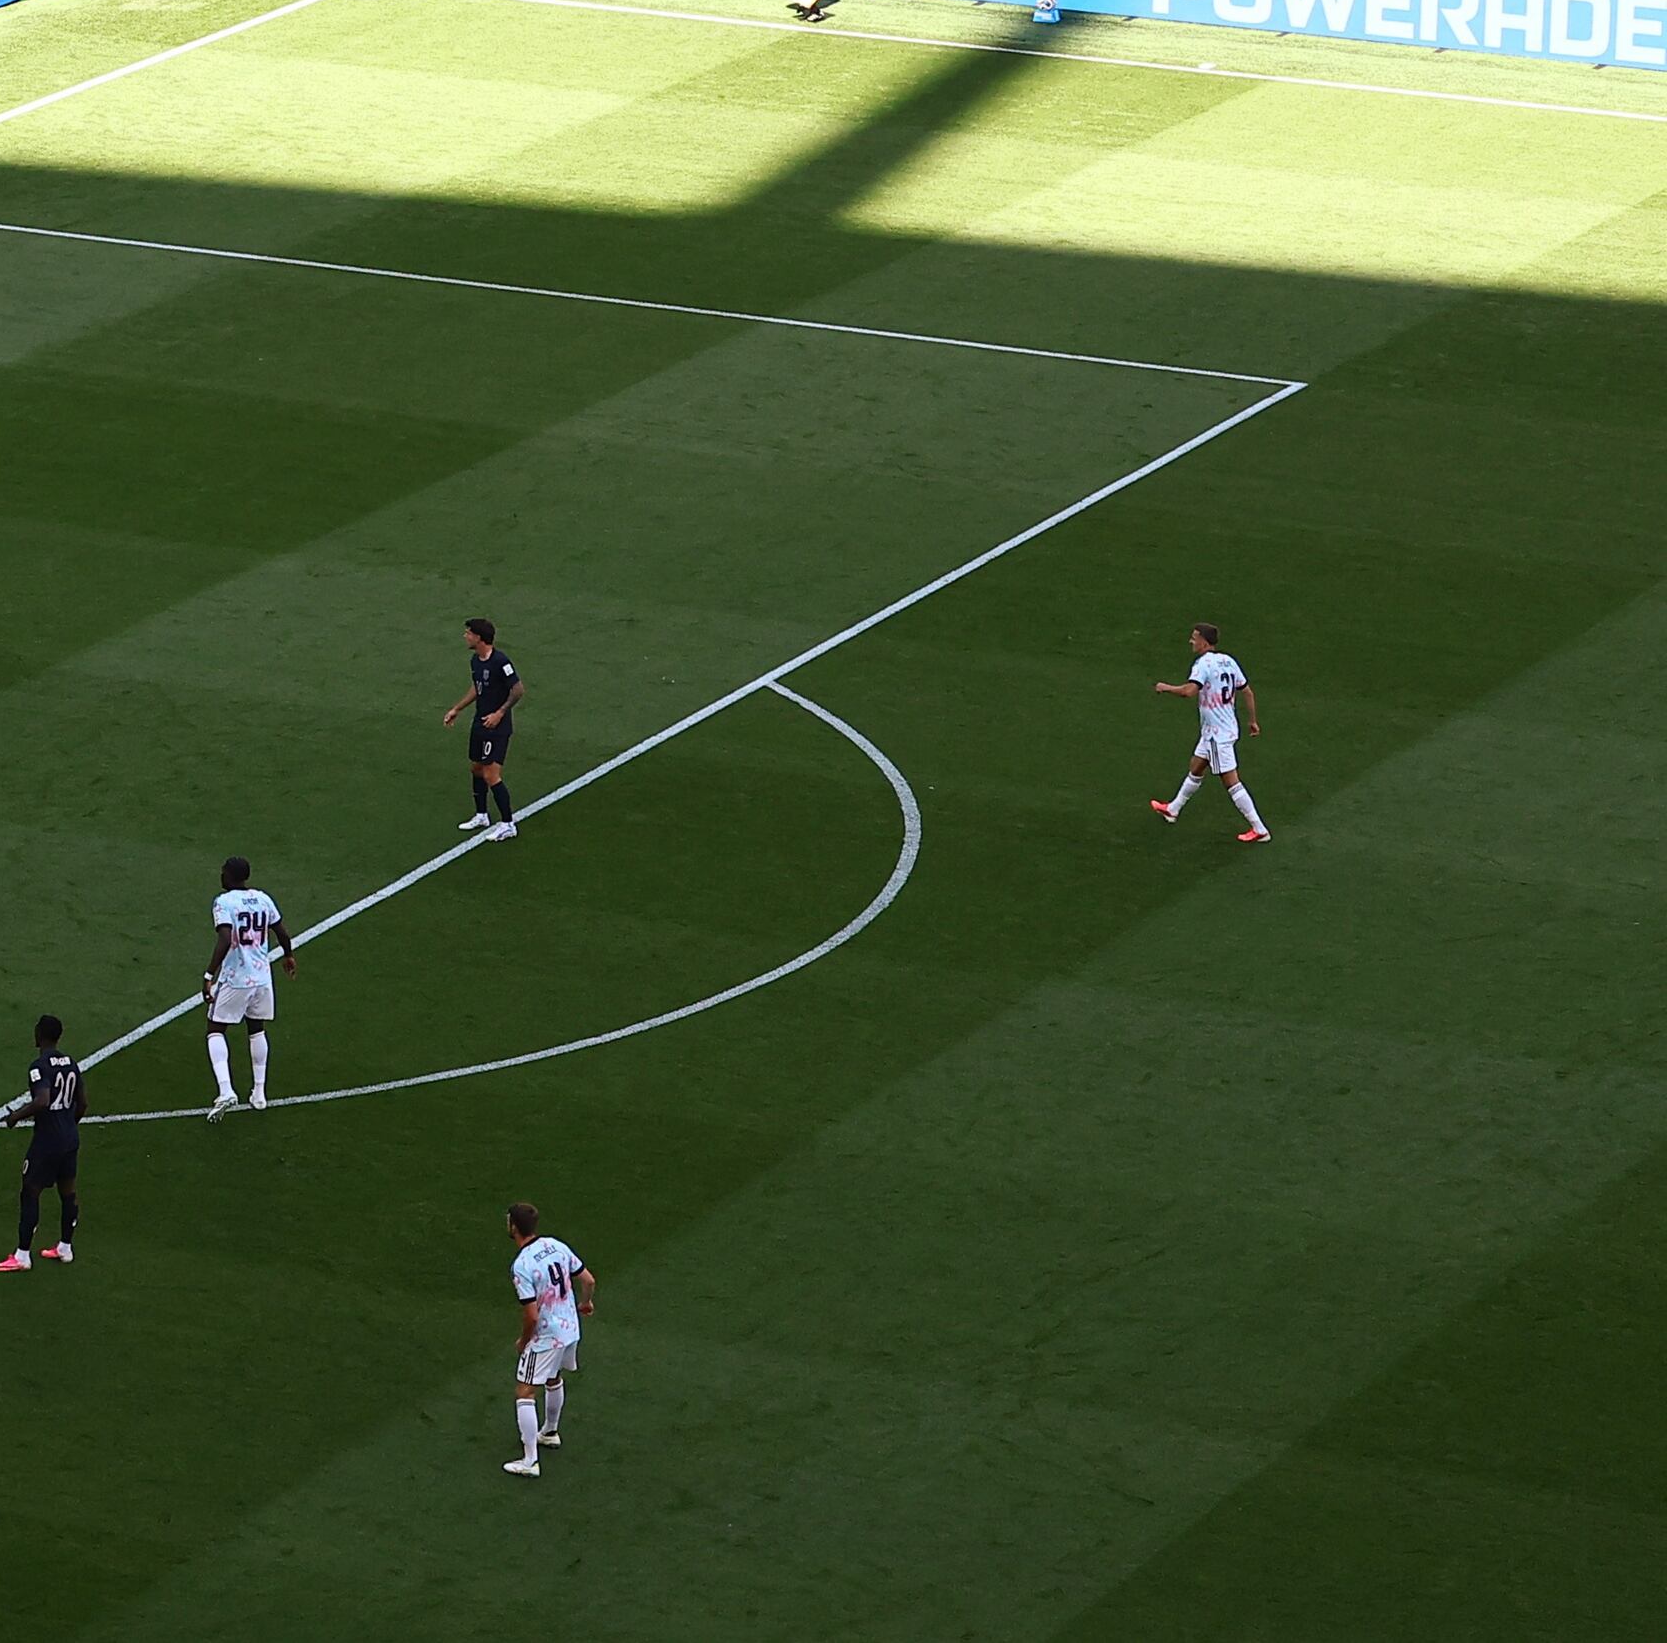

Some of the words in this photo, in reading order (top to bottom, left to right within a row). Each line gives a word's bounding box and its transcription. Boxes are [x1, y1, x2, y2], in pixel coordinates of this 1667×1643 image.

[238, 911, 264, 947] 24
[49, 1070, 77, 1112] 20
[548, 1262, 567, 1299] 4
